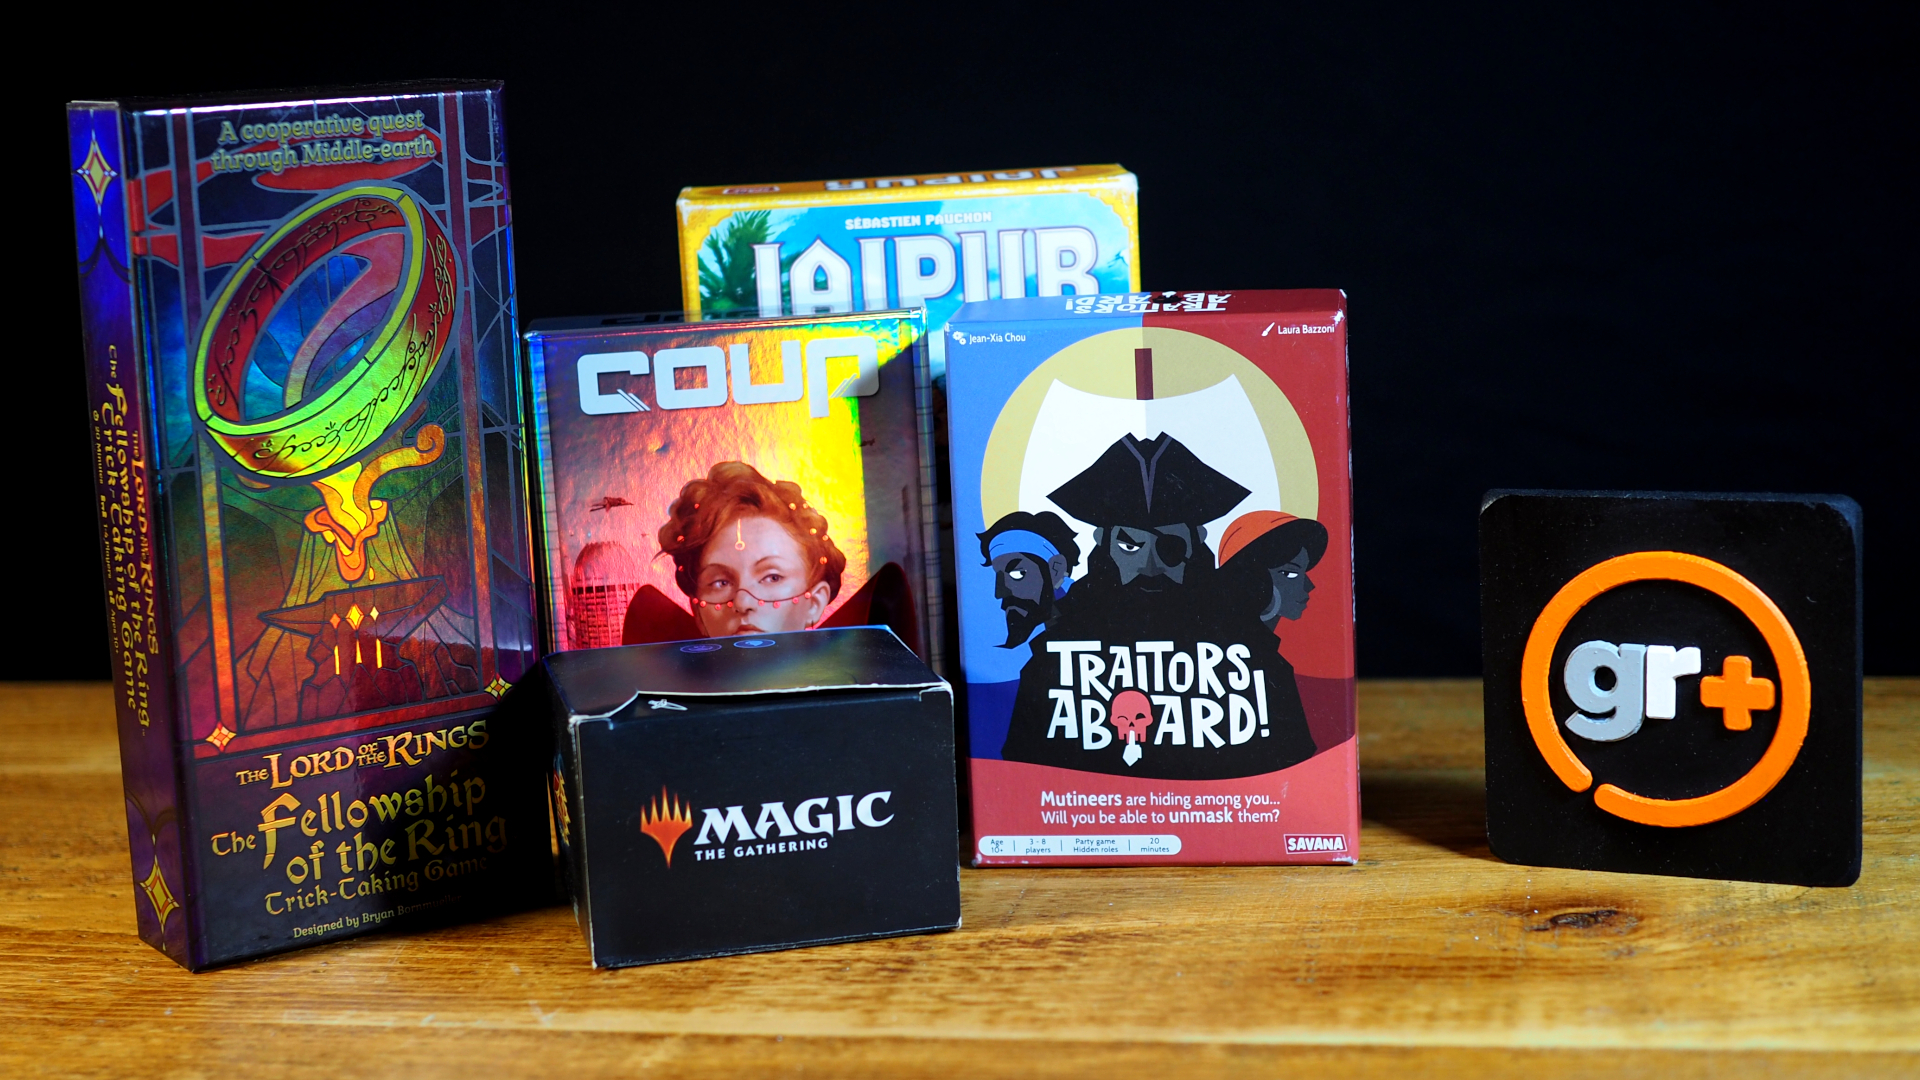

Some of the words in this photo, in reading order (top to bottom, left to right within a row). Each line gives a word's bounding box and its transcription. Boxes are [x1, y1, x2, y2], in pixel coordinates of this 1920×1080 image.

[218, 120, 236, 142] A
[242, 113, 364, 144] cooperative
[367, 110, 425, 137] quest
[211, 145, 298, 174] through
[301, 133, 435, 165] Middle-earth
[824, 167, 1077, 191] JAIPUR
[845, 213, 922, 230] SÉBASTIEN
[925, 211, 992, 227] PAUCHON
[751, 225, 1099, 318] JAIPUR
[968, 332, 1002, 345] Jean-Xia
[1005, 332, 1026, 344] Chou
[1277, 324, 1301, 335] Laura
[1303, 323, 1335, 334] Bazzoni
[109, 344, 117, 379] The
[576, 335, 881, 419] COUP
[106, 383, 135, 555] Fellowship
[102, 402, 127, 613] Trick-Taking
[121, 621, 136, 710] Game
[132, 458, 148, 534] LORD
[140, 558, 159, 655] RINGS
[127, 562, 141, 594] of
[131, 600, 143, 644] the
[1046, 640, 1251, 702] TRAITORS
[135, 650, 150, 728] Ring
[356, 751, 387, 767] THE
[358, 742, 379, 756] OF
[376, 719, 490, 769] RINGS
[235, 768, 270, 786] THE
[263, 746, 355, 790] LORD
[1040, 790, 1122, 807] Mutineers
[1126, 795, 1147, 806] are
[1150, 791, 1192, 810] hiding
[1194, 795, 1242, 809] among
[1245, 794, 1281, 809] you...
[211, 830, 257, 856] The
[257, 768, 487, 870] Fellowship
[693, 791, 895, 846] MAGIC
[1041, 811, 1068, 824] Will
[1071, 813, 1096, 828] you
[1100, 810, 1116, 824] be
[1119, 810, 1148, 824] able
[1151, 811, 1166, 824] to
[1169, 807, 1233, 824] unmask
[1238, 809, 1280, 823] them?
[286, 840, 325, 885] of
[335, 832, 397, 874] the
[404, 814, 508, 862] Ring
[694, 848, 726, 861] THE
[733, 838, 828, 858] GATHERING
[990, 838, 1004, 847] Age
[1025, 846, 1051, 855] players
[1073, 845, 1099, 853] Hidden
[1100, 845, 1119, 853] roles
[1075, 838, 1095, 846] Party
[1140, 845, 1170, 853] minutes
[1150, 837, 1160, 845] 20
[1287, 837, 1344, 851] SAVANA
[264, 869, 420, 916] Trick-Taking
[424, 855, 488, 881] Game
[293, 918, 344, 938] Designed
[345, 914, 360, 929] by
[362, 907, 395, 924] Bryan
